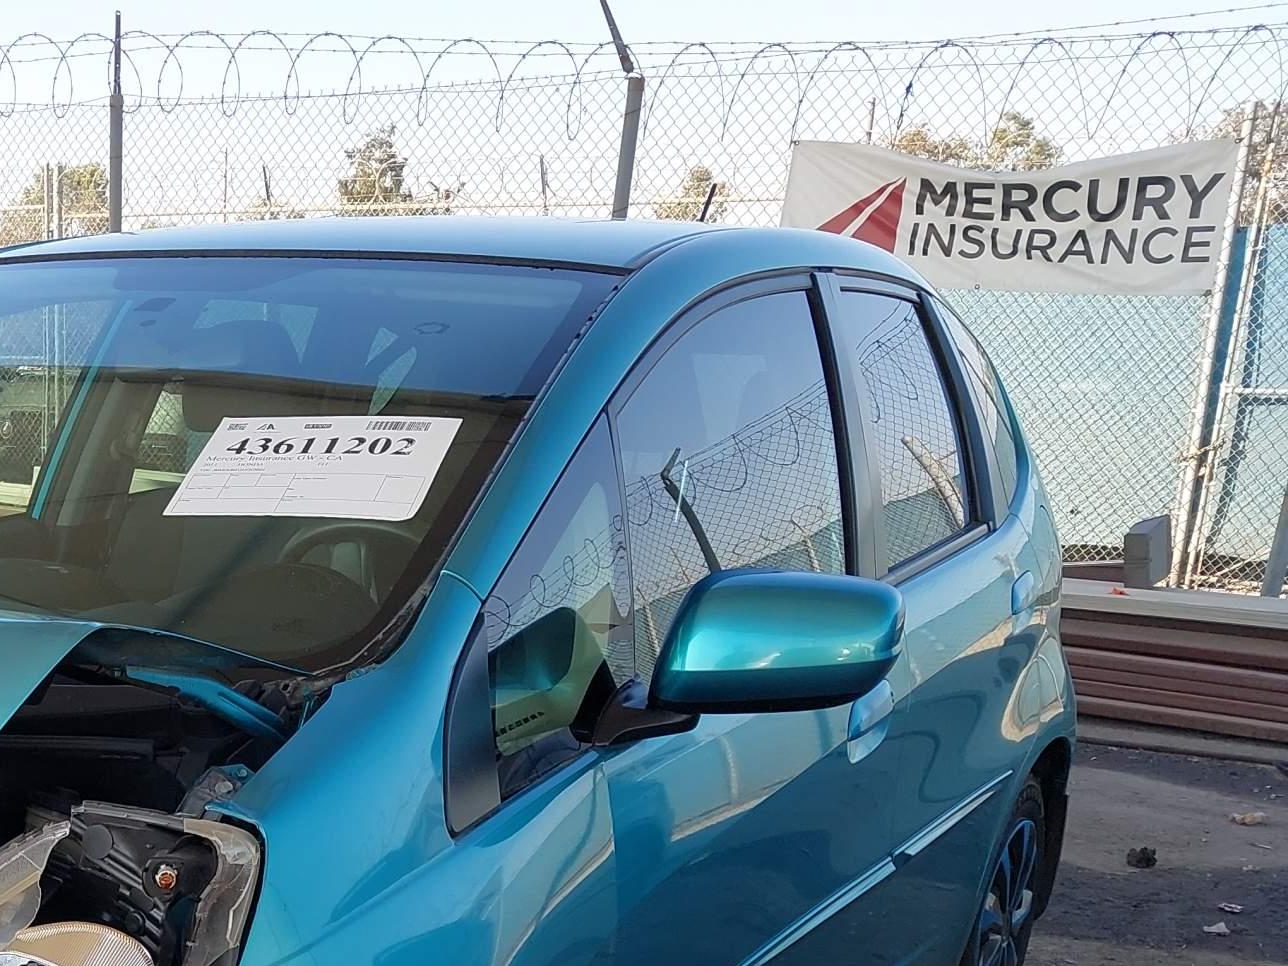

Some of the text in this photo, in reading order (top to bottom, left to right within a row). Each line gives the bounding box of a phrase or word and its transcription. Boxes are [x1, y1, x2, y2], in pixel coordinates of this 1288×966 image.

[915, 173, 1225, 223] MERCURY
[908, 223, 1216, 265] INSURANCE
[206, 455, 246, 463] Mercury
[226, 436, 417, 455] 43611202
